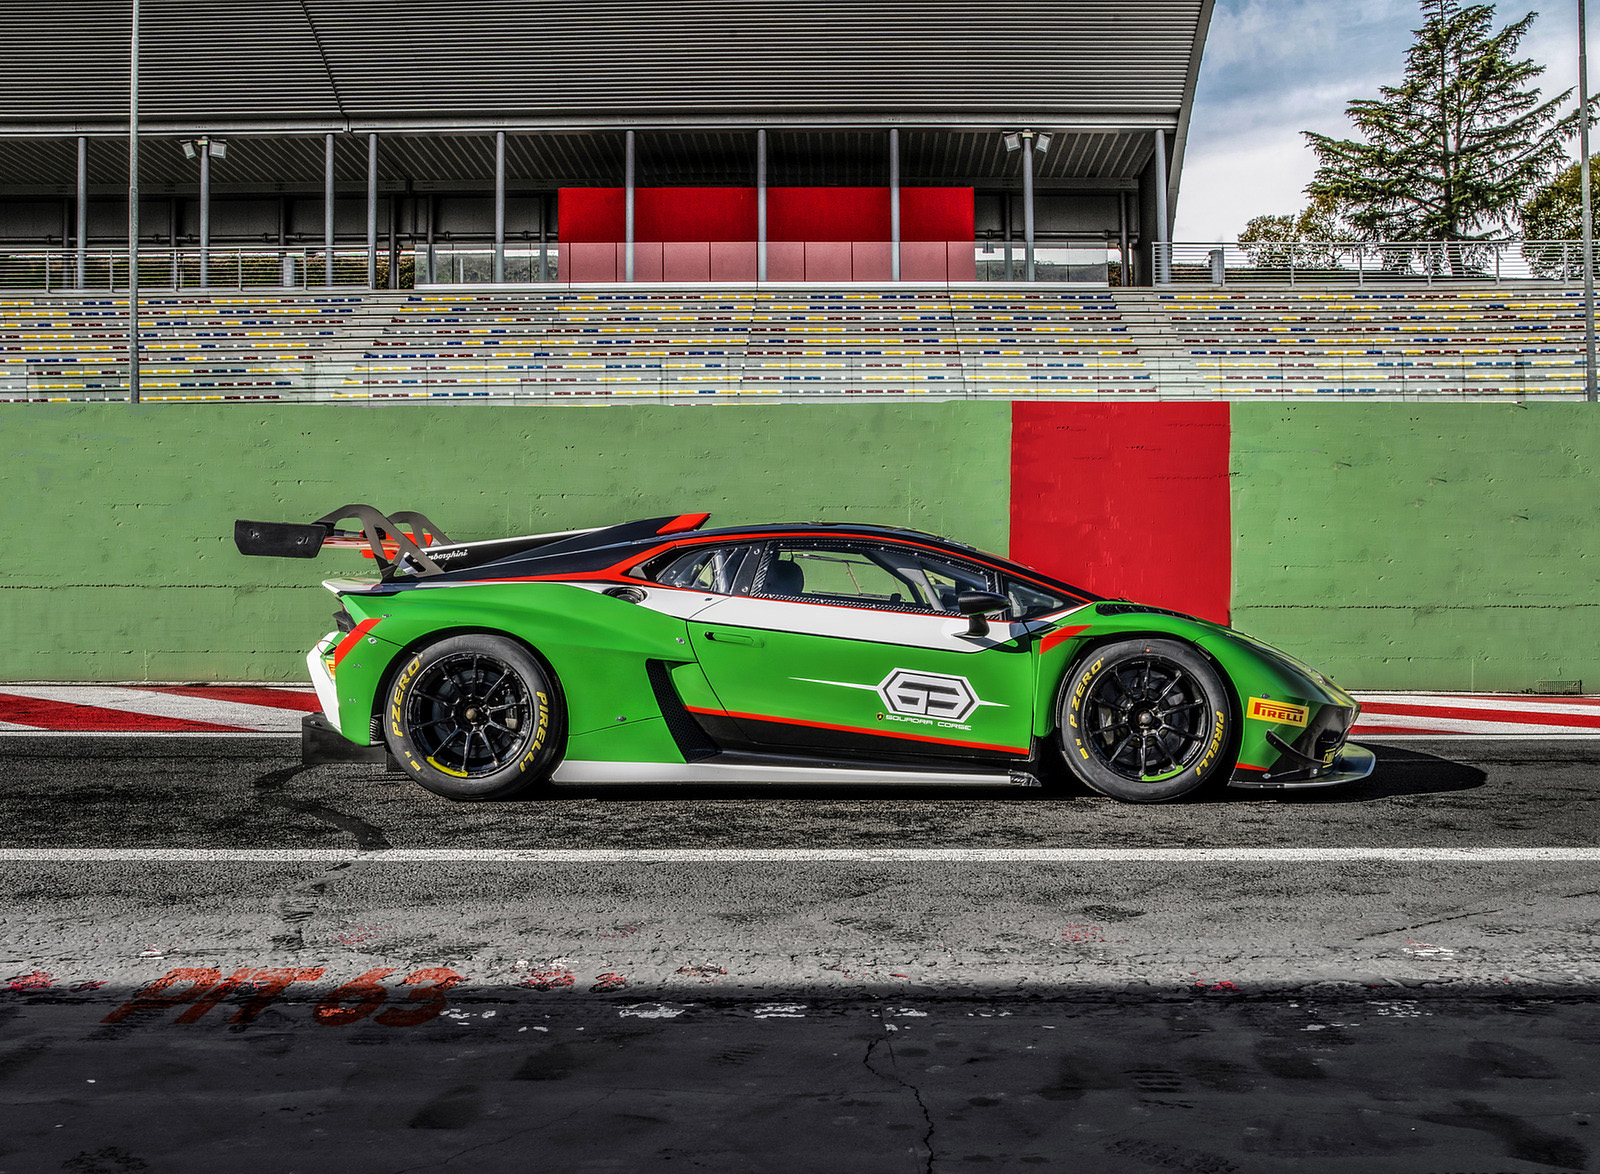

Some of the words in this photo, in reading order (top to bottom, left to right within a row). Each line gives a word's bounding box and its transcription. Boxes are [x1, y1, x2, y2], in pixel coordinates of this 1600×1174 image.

[1072, 660, 1102, 711] ZERO
[1254, 701, 1304, 723] PIRELLI
[520, 691, 549, 772] PIRELLI
[886, 714, 933, 726] SQUADRA
[937, 721, 972, 731] CORSE
[1195, 711, 1224, 775] PIRELLI
[100, 967, 328, 1025] PIT
[313, 967, 460, 1027] 63
